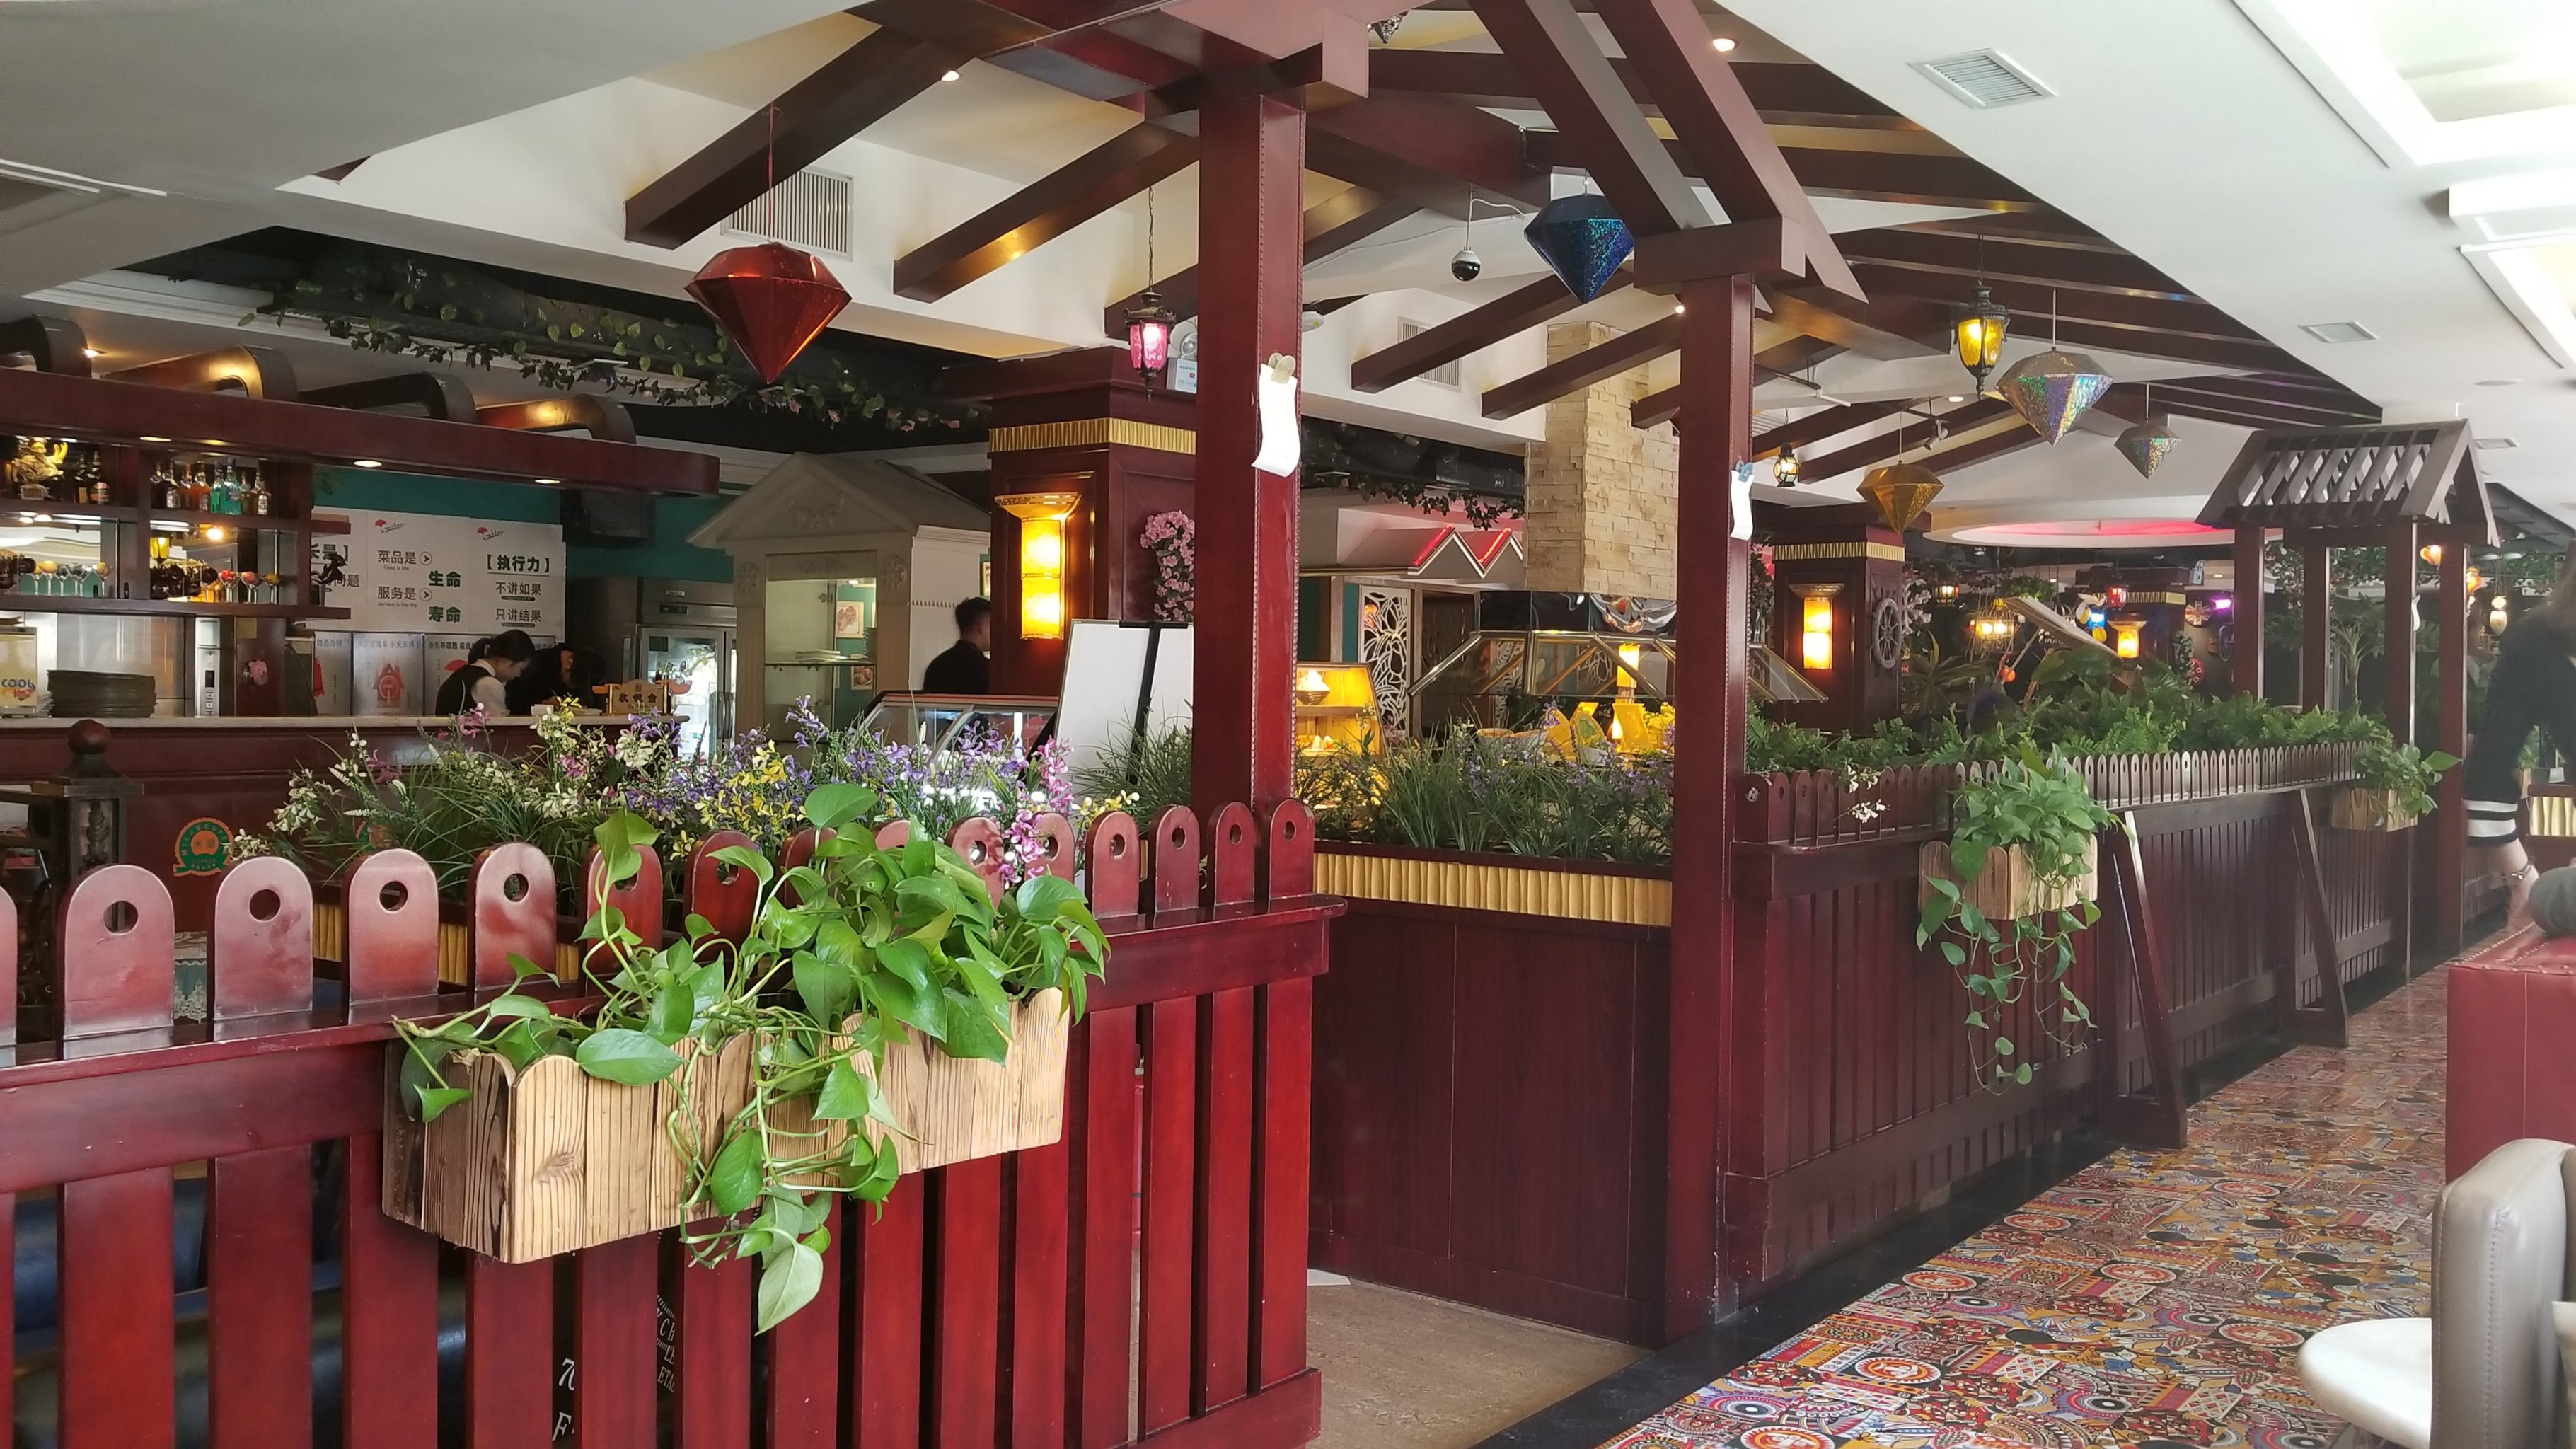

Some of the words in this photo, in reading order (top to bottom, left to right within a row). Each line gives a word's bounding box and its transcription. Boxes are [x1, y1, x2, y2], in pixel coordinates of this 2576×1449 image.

[377, 550, 417, 565] 菜品是
[428, 570, 461, 588] 生命
[377, 585, 417, 601] 服务是
[495, 582, 542, 596] 不讲如果
[428, 606, 461, 623] 寿命
[495, 608, 542, 623] 只讲结果
